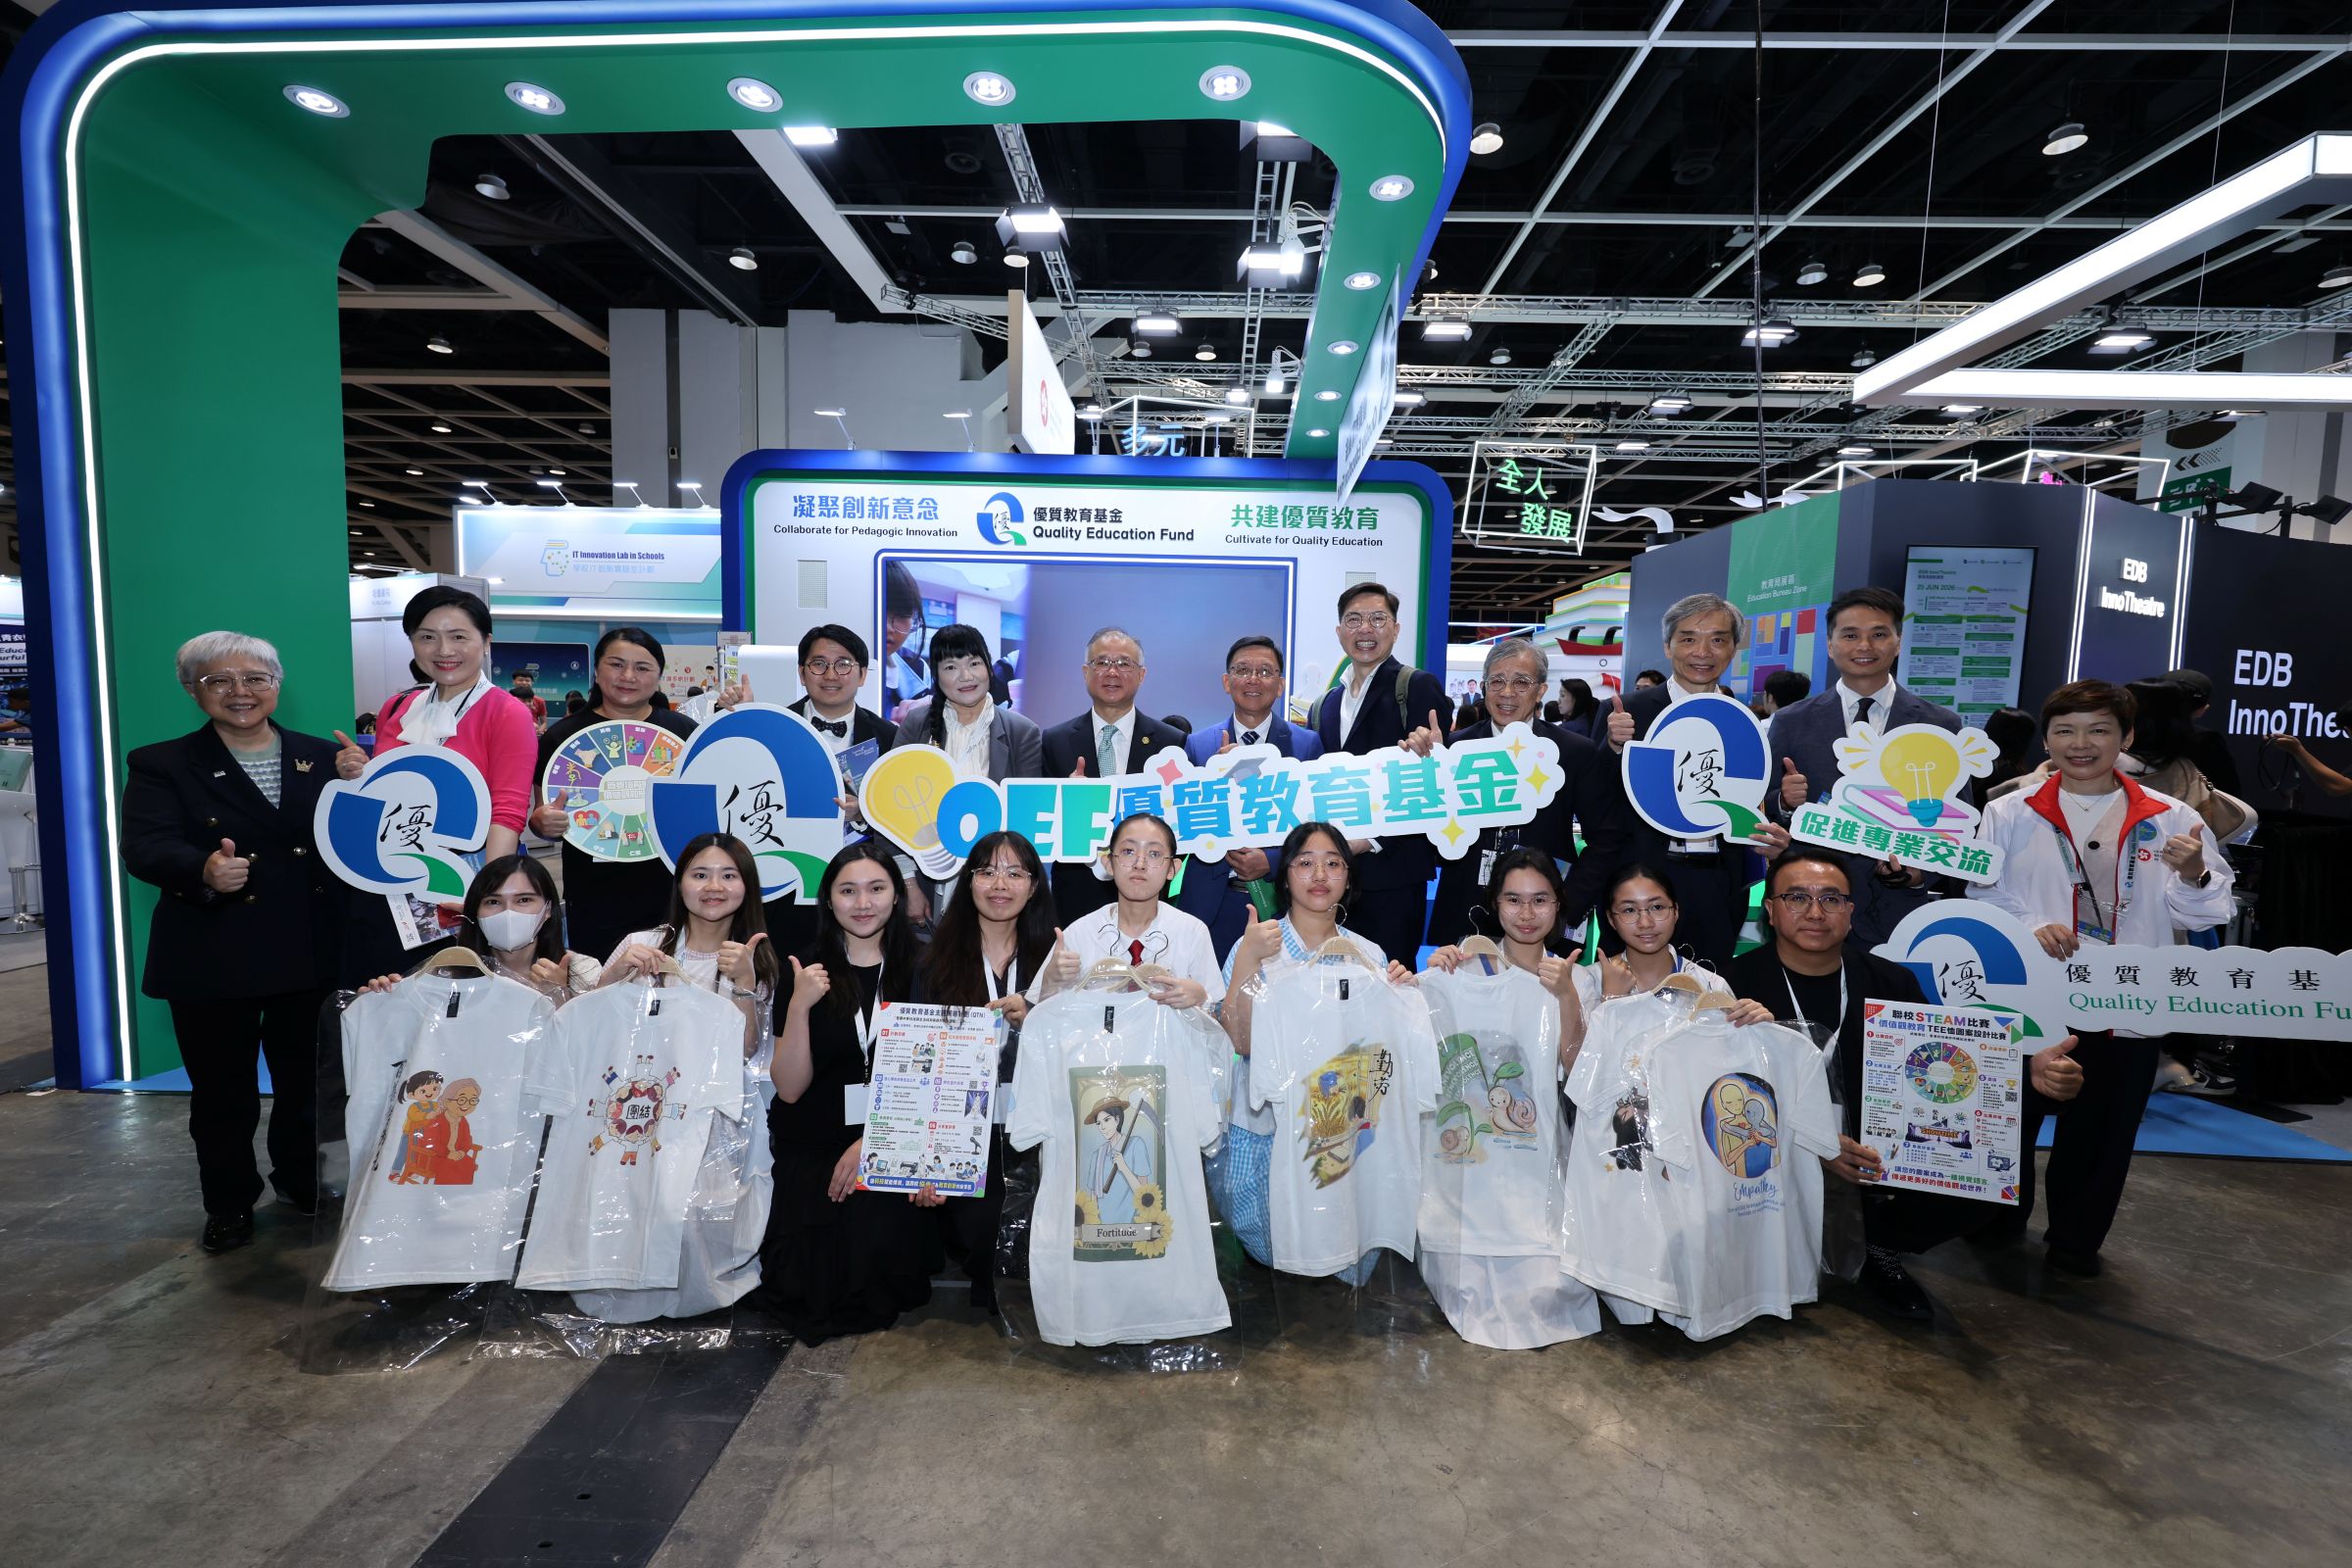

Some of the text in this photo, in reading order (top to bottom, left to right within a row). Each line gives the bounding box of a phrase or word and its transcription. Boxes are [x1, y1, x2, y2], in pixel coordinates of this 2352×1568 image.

[1120, 423, 1186, 457] 多元
[1495, 459, 1548, 500] 全人
[793, 495, 940, 520] 凝聚創新意念
[1033, 507, 1123, 523] 優質教育基金
[1231, 504, 1379, 530] 共建優質教育
[773, 524, 958, 539] Collaborate for Pedagogic Innovation
[1033, 525, 1195, 542] Quality Education Fund
[1521, 502, 1572, 544] 發展
[1225, 534, 1383, 548] Cultivate for Quality Education
[580, 551, 616, 560] Innovation
[638, 552, 665, 561] Schools
[2123, 558, 2148, 583] EDB
[1747, 585, 1808, 603] Education Bureau Zone
[2100, 585, 2166, 617] InnoTheatre
[2233, 649, 2293, 687] EDB
[2229, 699, 2349, 739] InnoThe
[1677, 749, 1724, 799] 優
[723, 779, 785, 848] 優
[379, 803, 432, 853] 優
[1799, 810, 1993, 876] 促進專業交流
[1937, 959, 1986, 1003] 優
[2065, 963, 2320, 992] 優質教育基
[1892, 1009, 1990, 1029] 聯校STEAM比賽
[2069, 992, 2352, 1020] Quality Education Fu
[626, 1103, 652, 1119] 團結
[1734, 1176, 1780, 1201] Empathy
[1097, 1226, 1138, 1238] Fortitude
